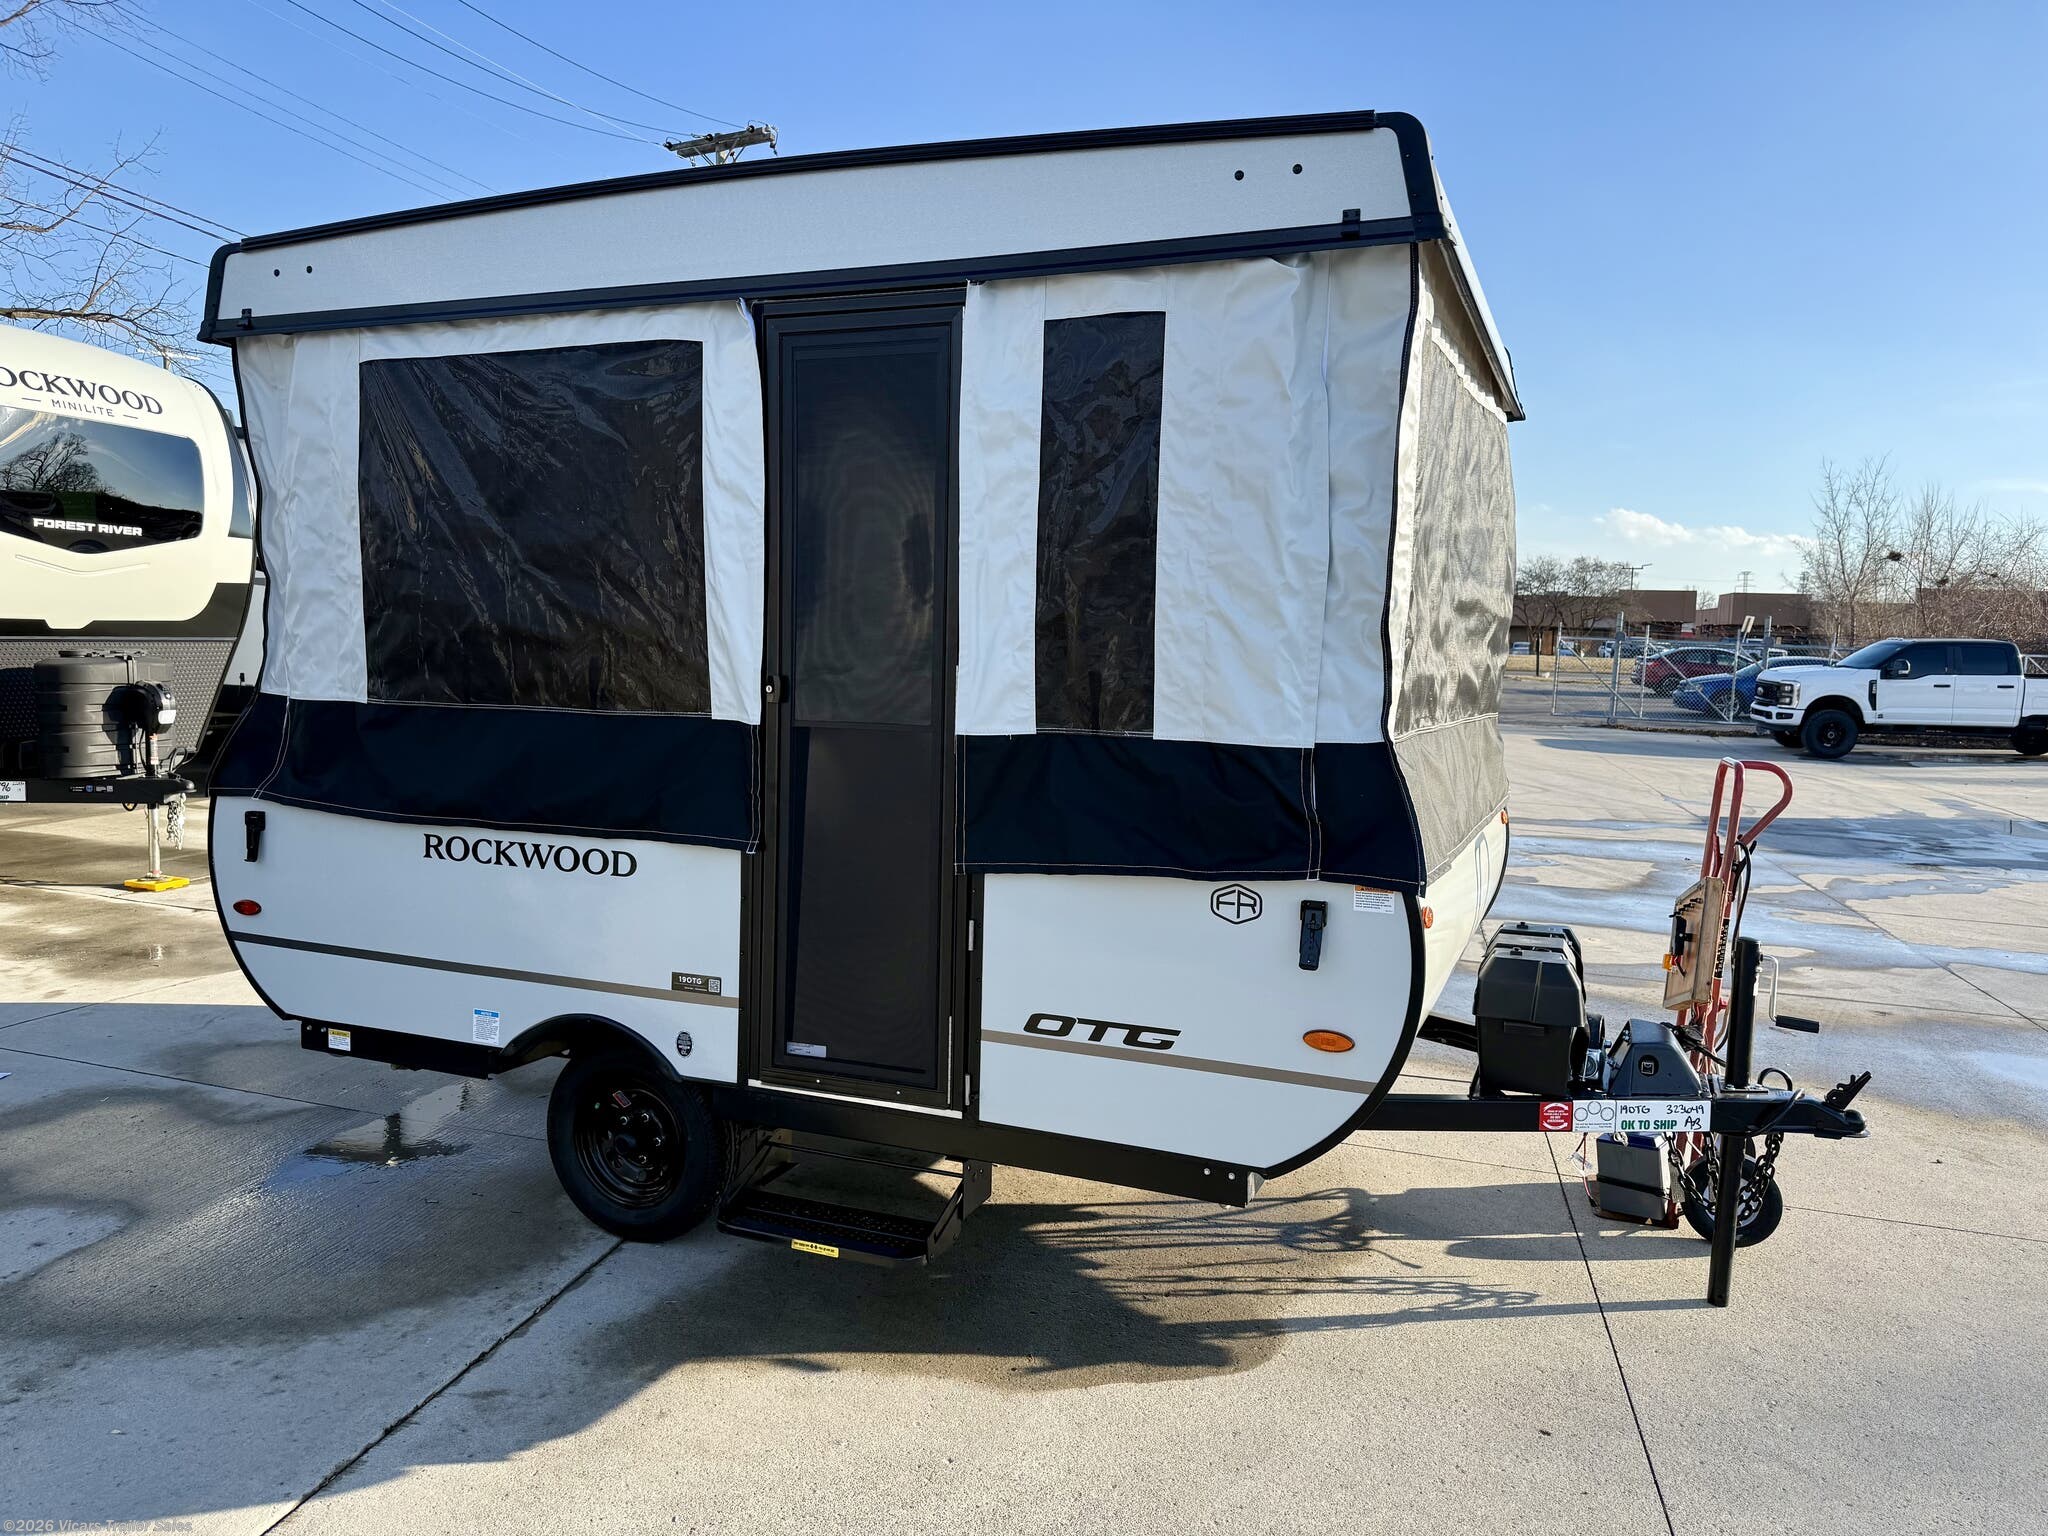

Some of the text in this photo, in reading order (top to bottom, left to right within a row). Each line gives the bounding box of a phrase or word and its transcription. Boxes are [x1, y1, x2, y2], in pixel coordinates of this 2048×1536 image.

[51, 399, 115, 417] MINILITE
[33, 518, 142, 536] FOREST RIVER
[423, 833, 637, 877] ROCKWOOD
[1023, 1012, 1182, 1050] OTG
[1621, 1119, 1635, 1130] OK
[1638, 1119, 1651, 1130] TO
[1653, 1119, 1677, 1130] SHIP
